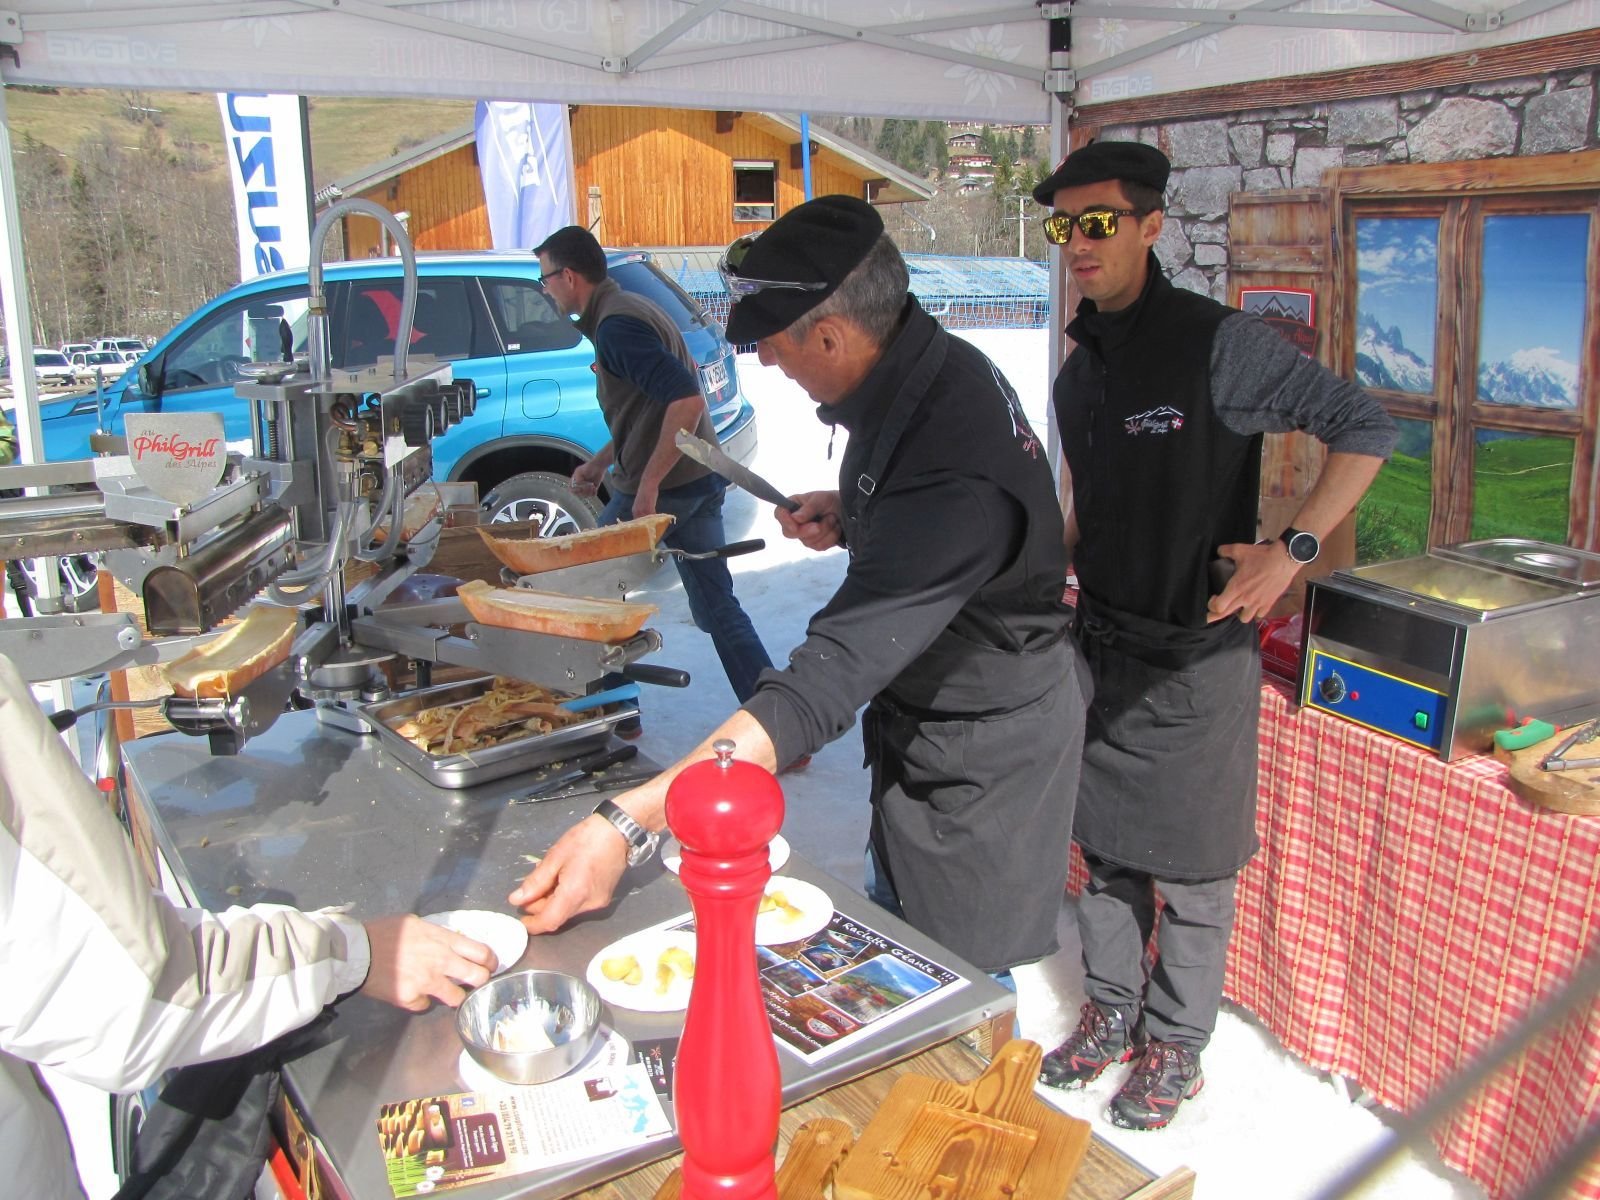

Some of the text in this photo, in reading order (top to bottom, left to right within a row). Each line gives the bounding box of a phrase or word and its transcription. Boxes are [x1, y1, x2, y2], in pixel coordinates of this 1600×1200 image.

[165, 459, 217, 472] des Alpes
[842, 922, 888, 950] Raclette
[891, 948, 935, 974] Géante
